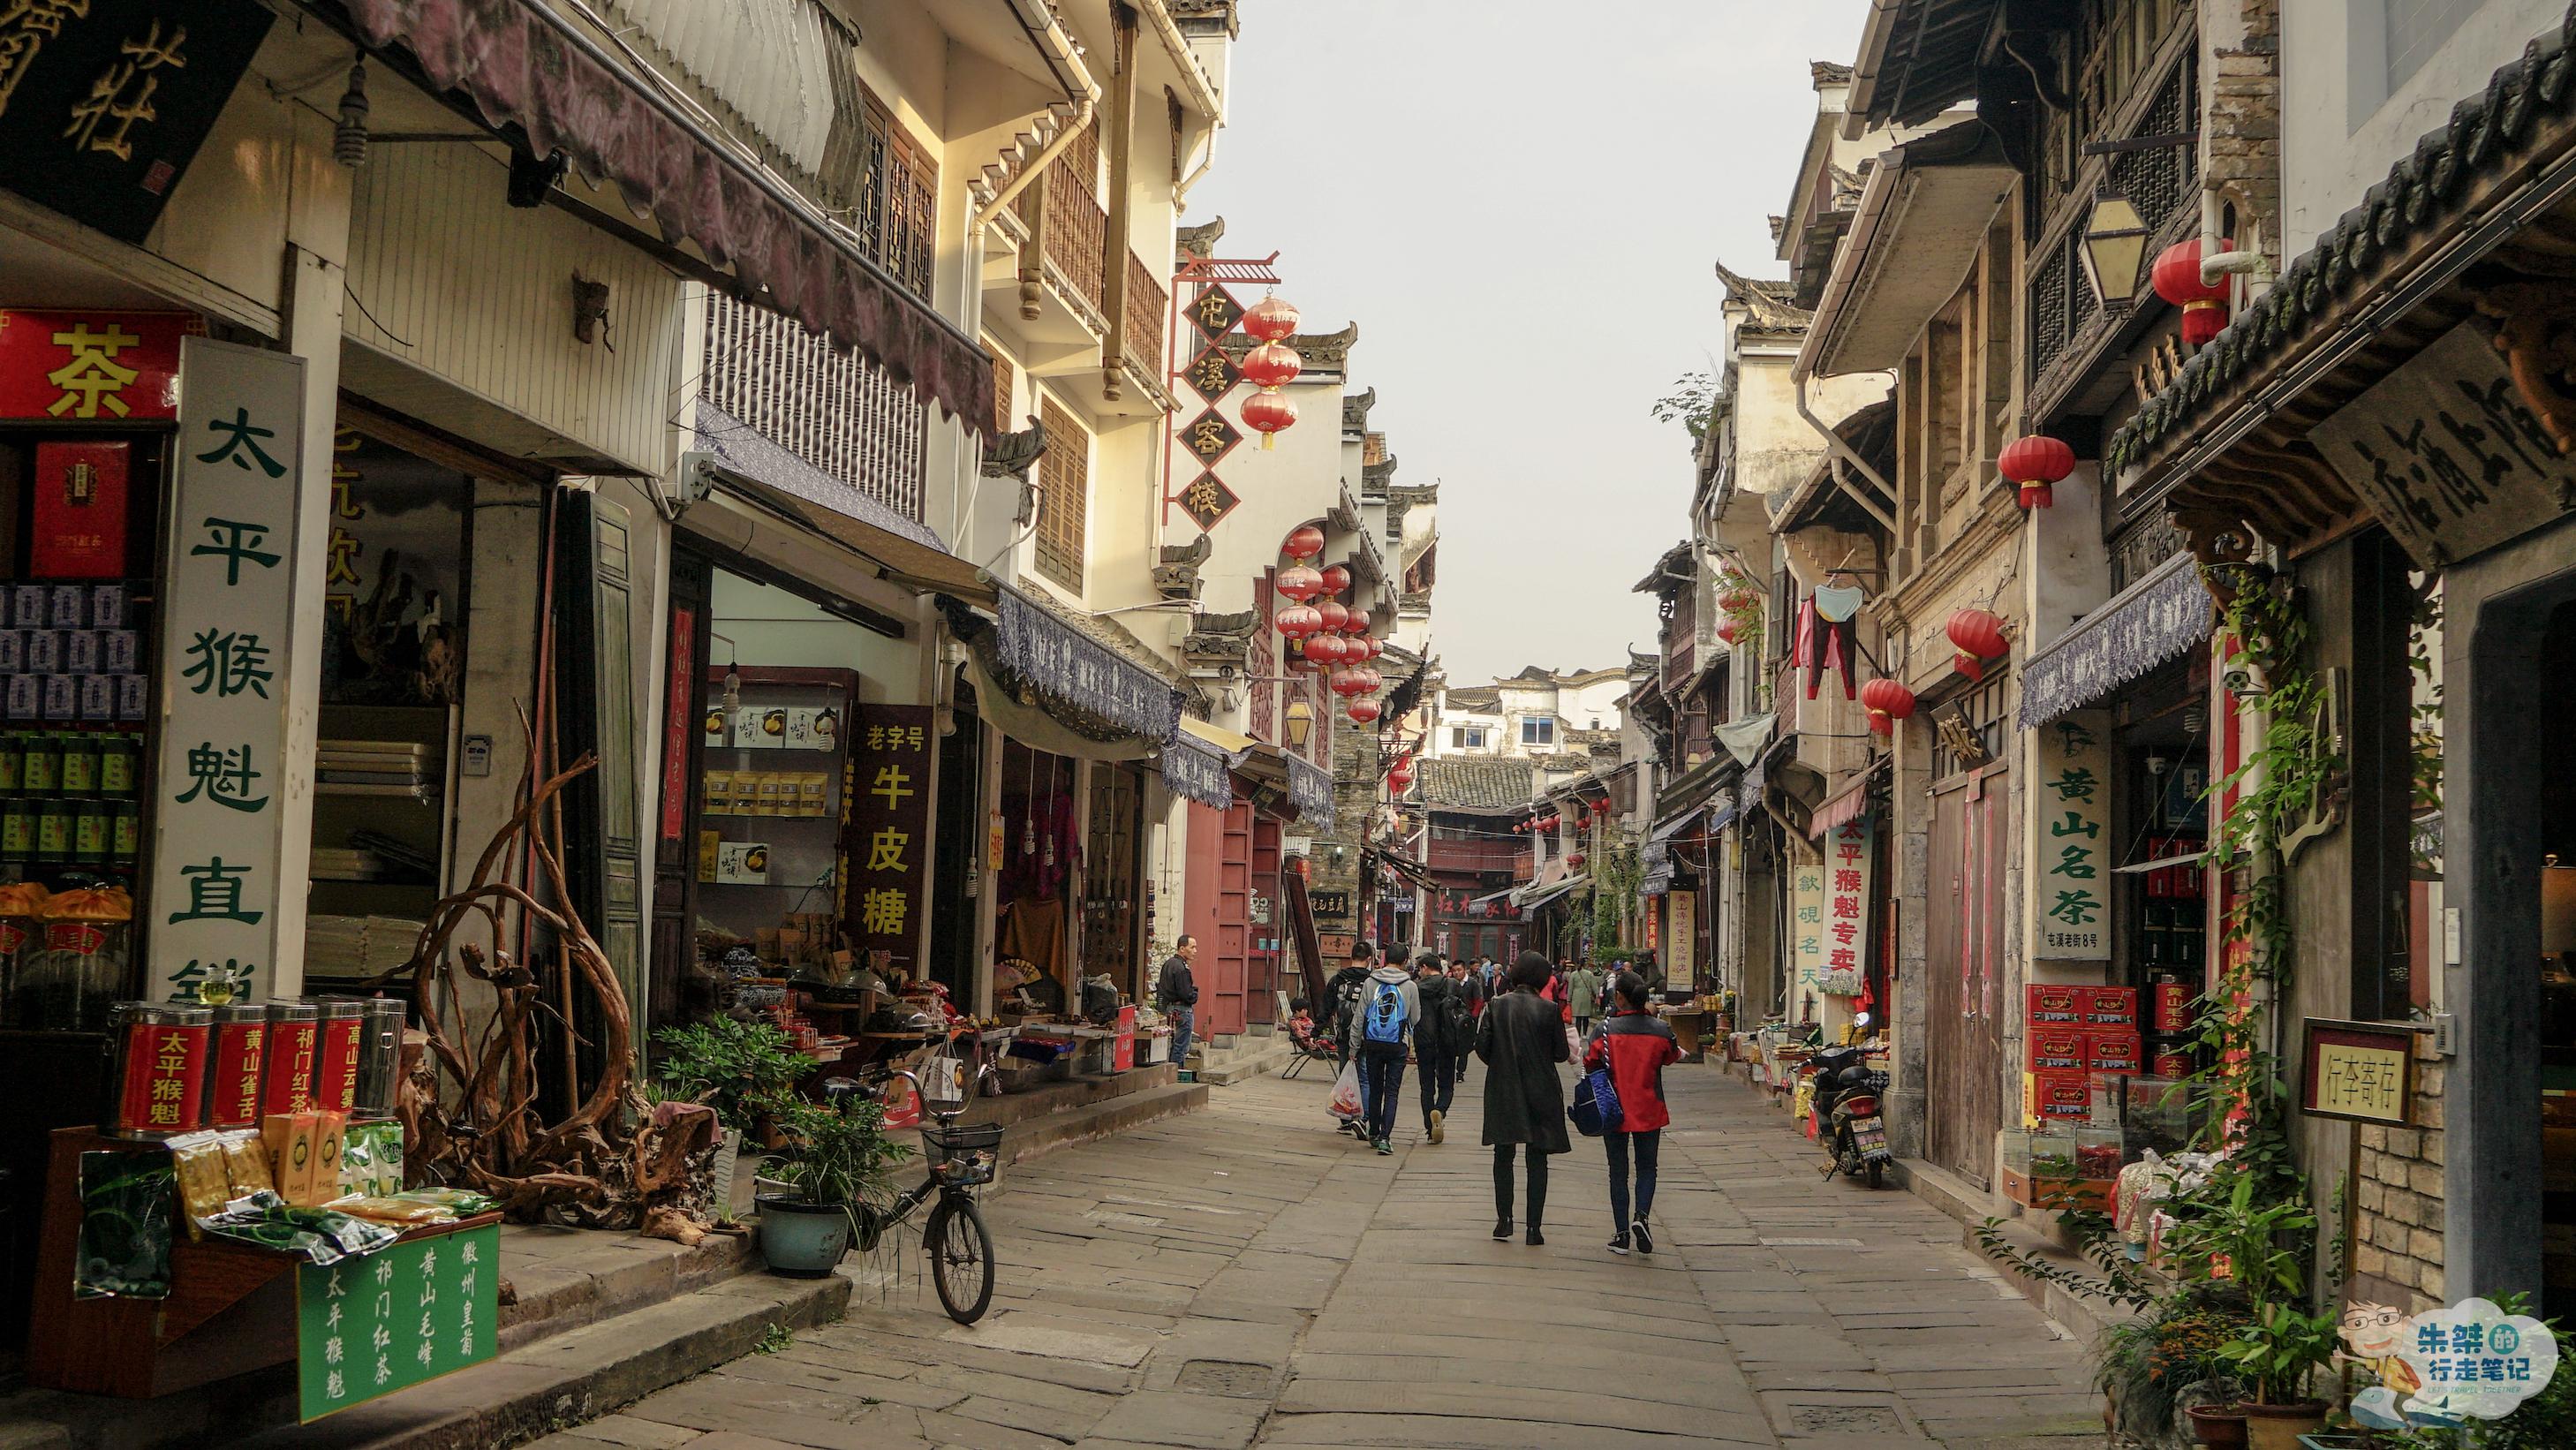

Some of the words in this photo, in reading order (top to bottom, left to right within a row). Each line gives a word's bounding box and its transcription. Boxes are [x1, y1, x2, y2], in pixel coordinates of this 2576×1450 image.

[47, 323, 140, 418] 茶
[867, 725, 925, 751] 老字号
[862, 765, 914, 934] 牛皮糖
[2045, 767, 2103, 925] 黄山名茶
[1830, 819, 1865, 972] 太平猴魁专卖
[2047, 932, 2097, 948] 屯溪老街8号
[149, 1031, 189, 1124] 太平猴魁
[238, 1029, 262, 1118] 黄山雀舌
[290, 1028, 314, 1114] 祁门红茶
[340, 1024, 361, 1108] 高山云雾
[2325, 1054, 2395, 1110] 行李寄存
[325, 1268, 346, 1400] 太平猴魁
[373, 1258, 392, 1386] 祁门红茶
[417, 1247, 437, 1371] 黄山毛峰
[459, 1241, 479, 1357] 徽州皇菊
